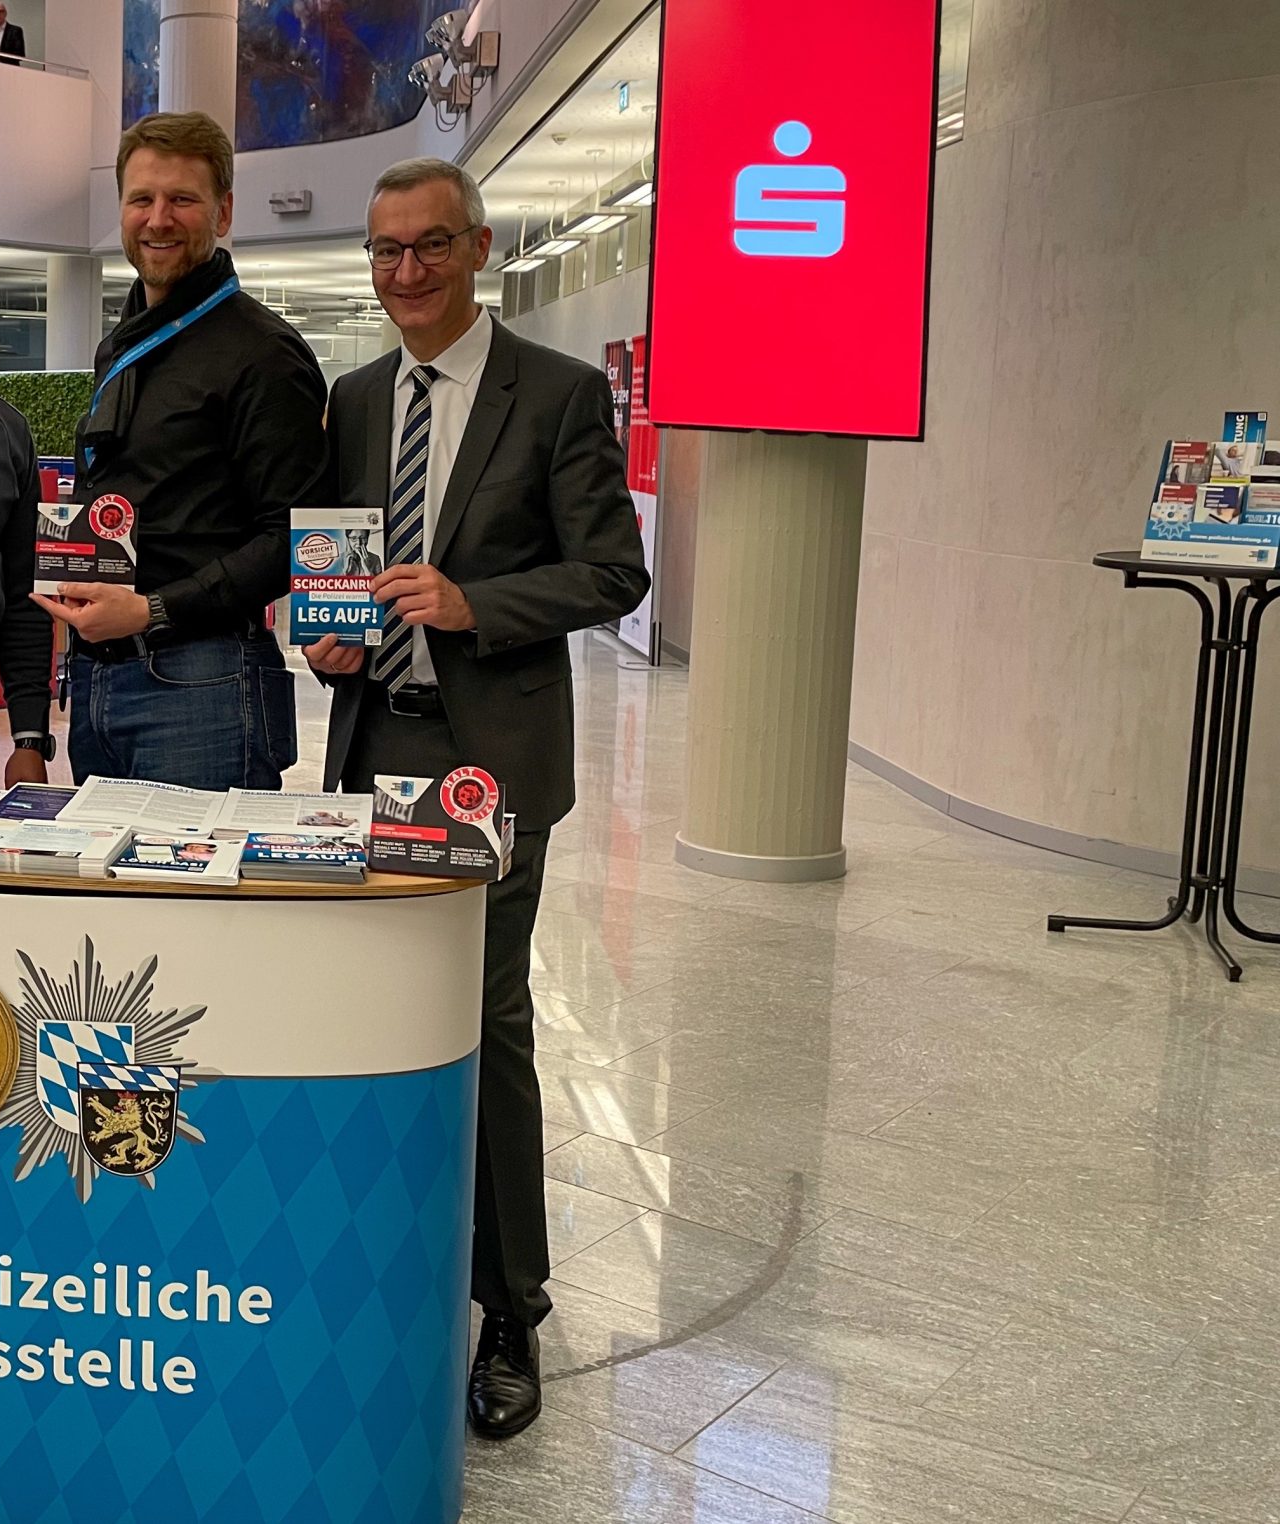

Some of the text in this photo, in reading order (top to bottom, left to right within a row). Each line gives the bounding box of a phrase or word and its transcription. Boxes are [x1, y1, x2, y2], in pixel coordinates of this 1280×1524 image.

[1233, 414, 1245, 443] TUNG
[91, 495, 116, 512] HALT
[99, 513, 134, 539] POLIZEI
[300, 545, 334, 555] VORSICHT
[297, 607, 378, 624] LEG AUF!
[443, 768, 475, 788] HALT
[453, 791, 497, 822] POLIZEI
